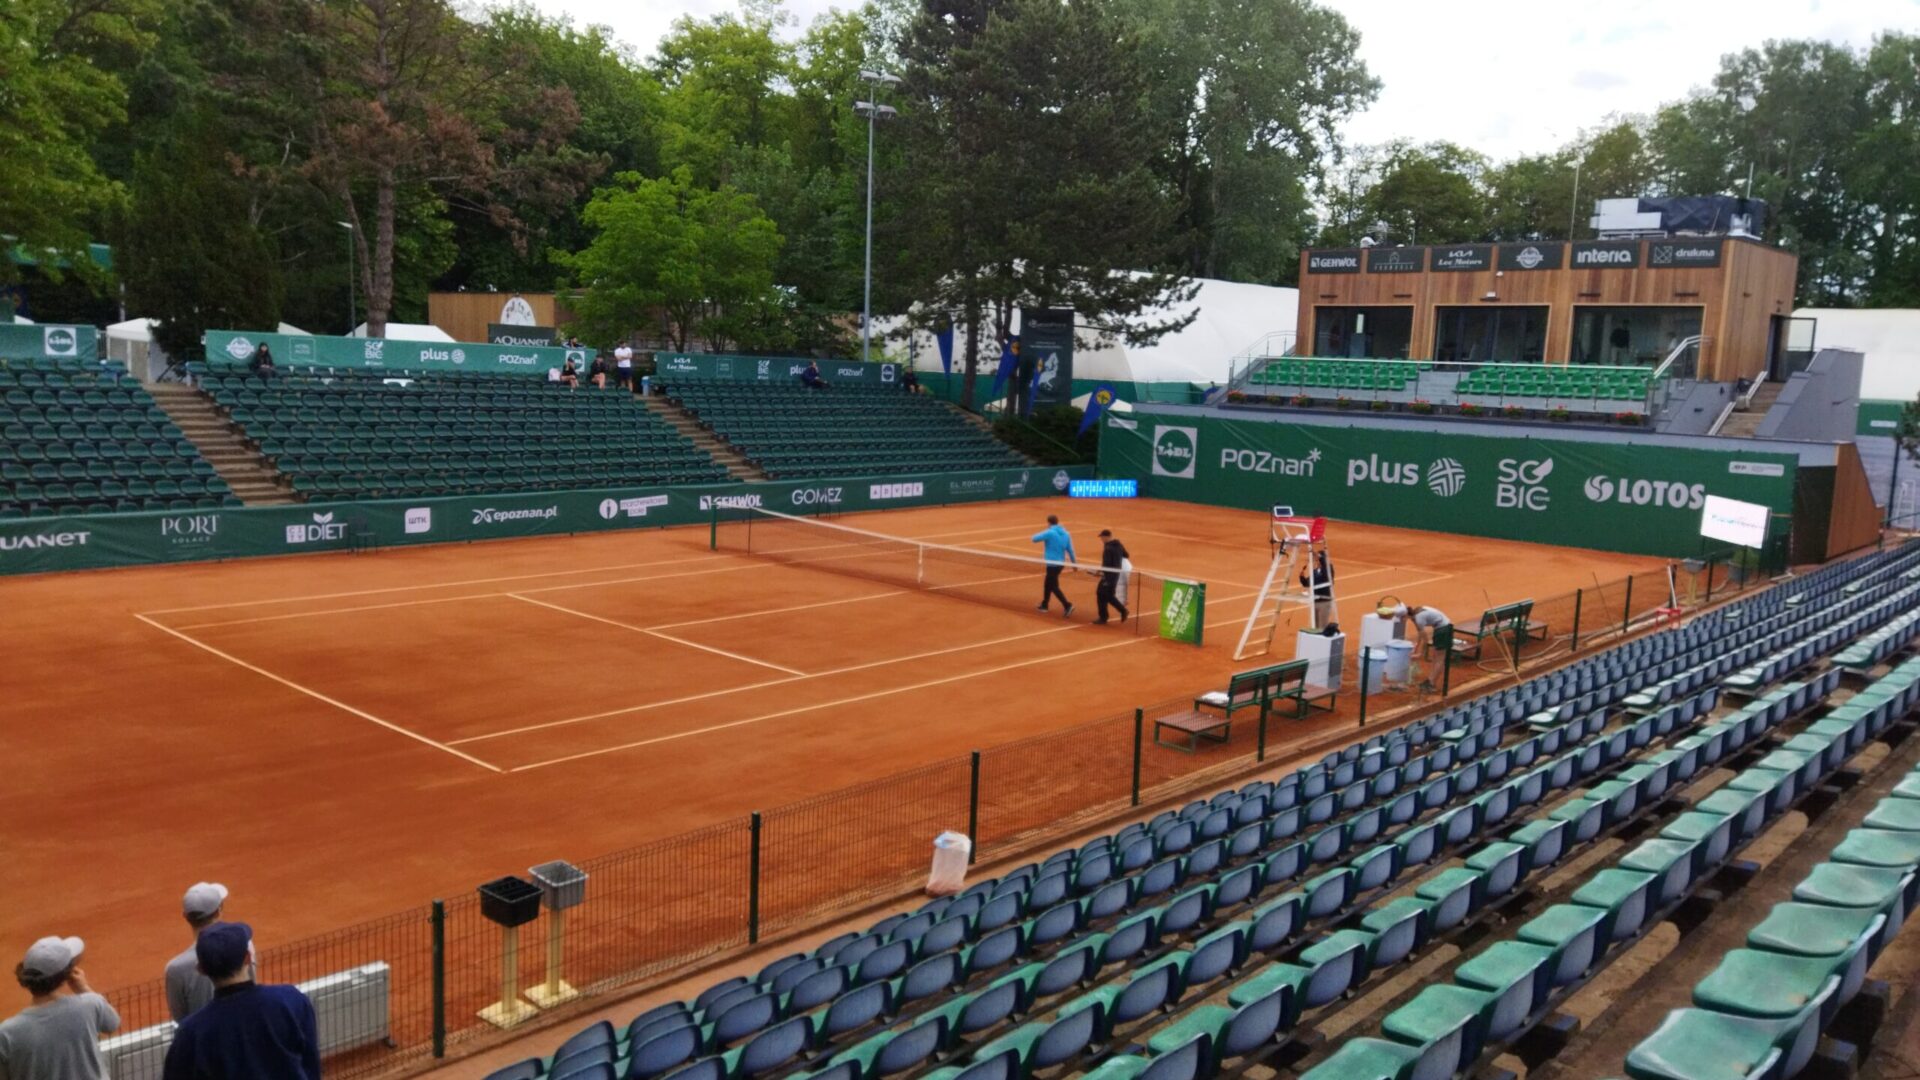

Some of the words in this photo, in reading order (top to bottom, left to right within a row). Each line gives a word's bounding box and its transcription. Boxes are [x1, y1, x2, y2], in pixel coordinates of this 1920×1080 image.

[1577, 248, 1632, 263] interia
[1675, 247, 1716, 258] drukma
[1320, 257, 1357, 268] GEHWOL
[420, 348, 449, 362] plus
[1346, 453, 1420, 487] plus
[792, 487, 843, 506] GOMEZ
[1617, 477, 1706, 510] LOTOS
[493, 506, 558, 522] epoznan.pl
[161, 514, 220, 536] PORT
[307, 523, 348, 541] DIET
[1166, 588, 1183, 625] ATP
